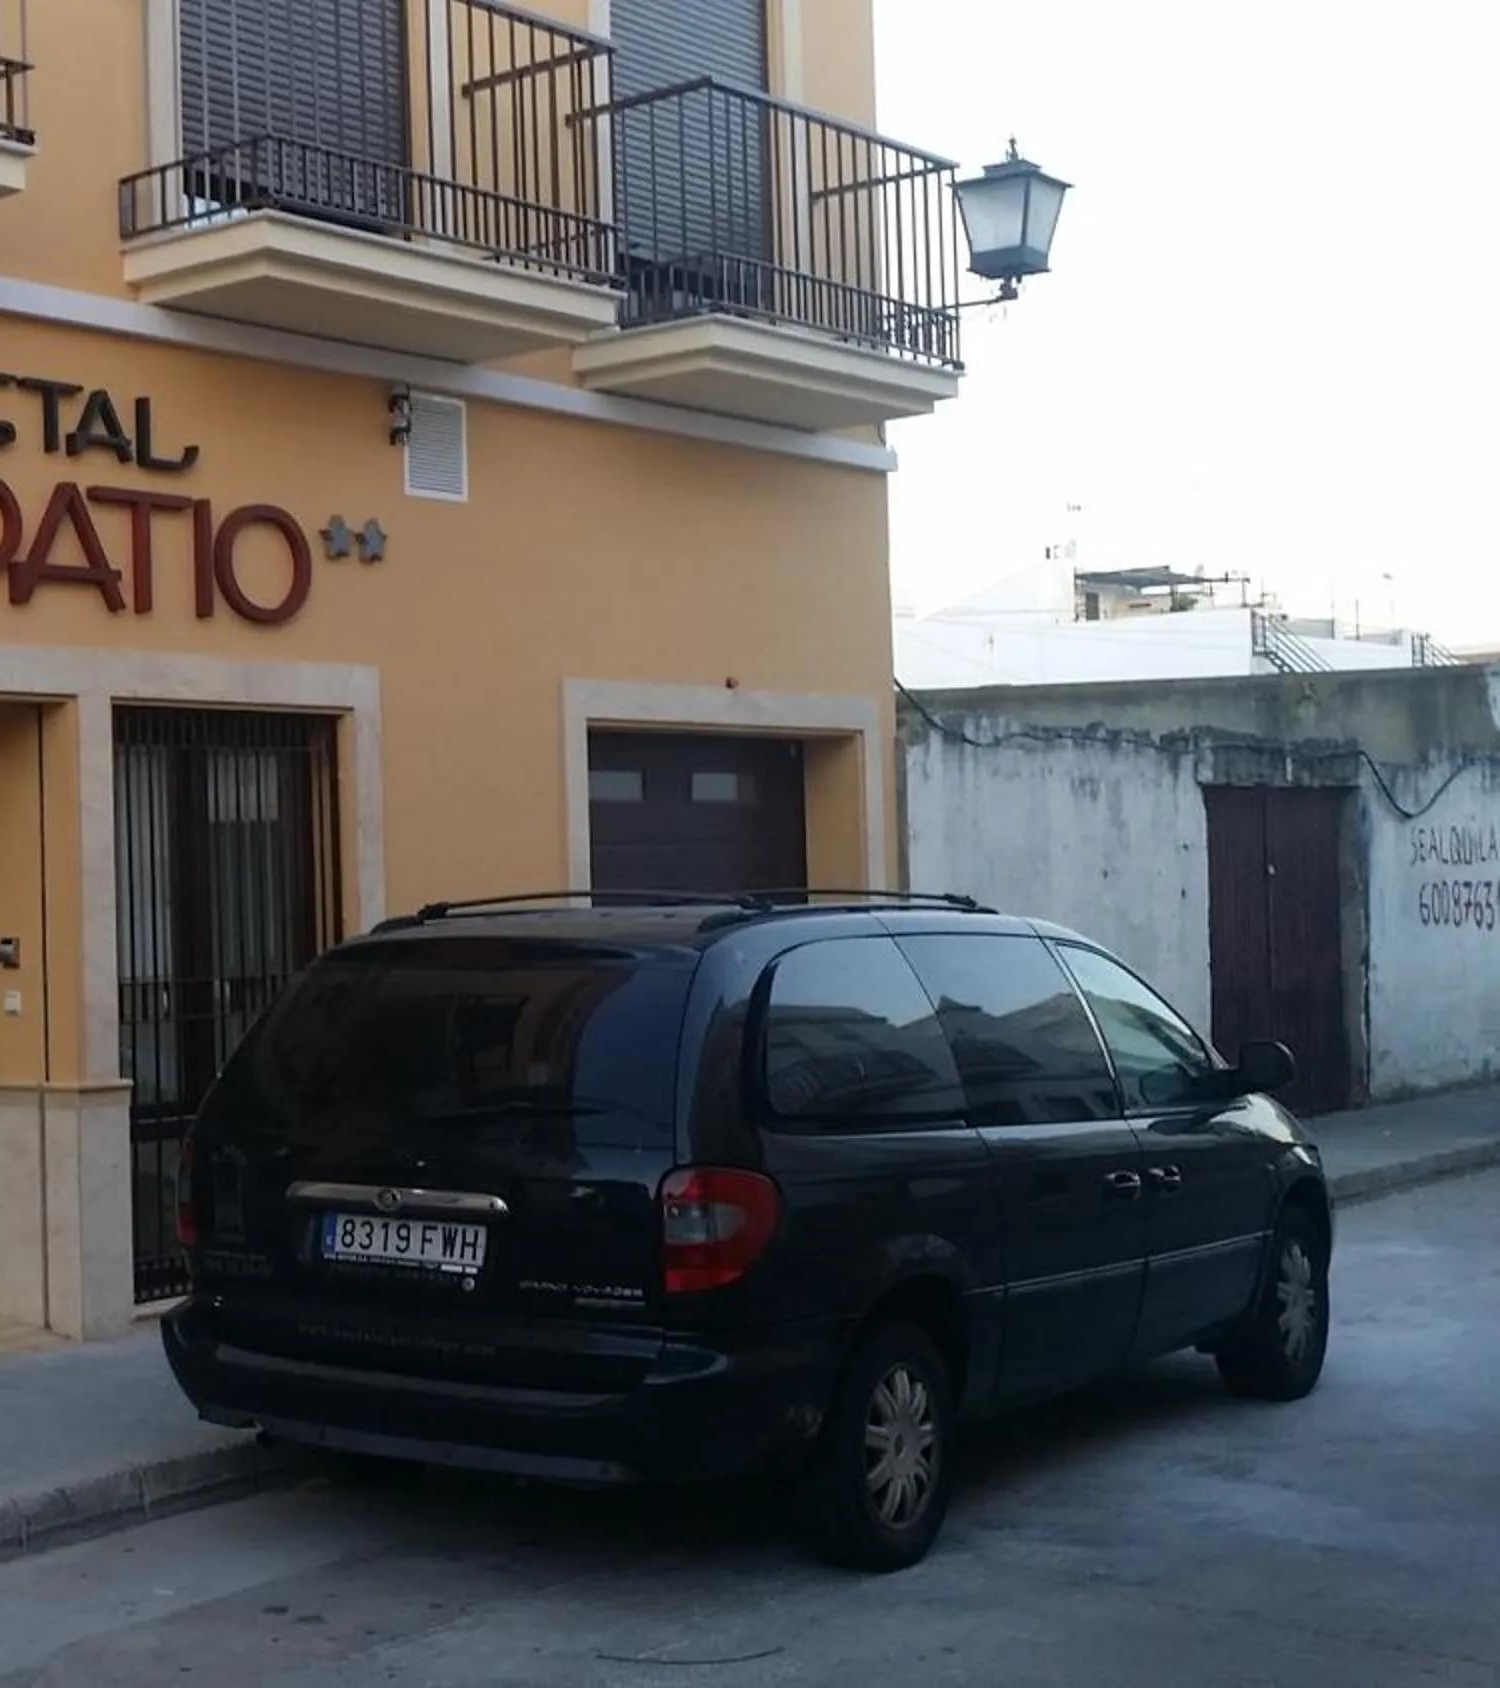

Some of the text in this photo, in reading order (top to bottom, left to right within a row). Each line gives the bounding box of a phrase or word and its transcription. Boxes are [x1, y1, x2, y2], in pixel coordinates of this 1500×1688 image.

[1418, 879, 1500, 932] 6008763
[340, 1218, 480, 1262] 8319 FWH
